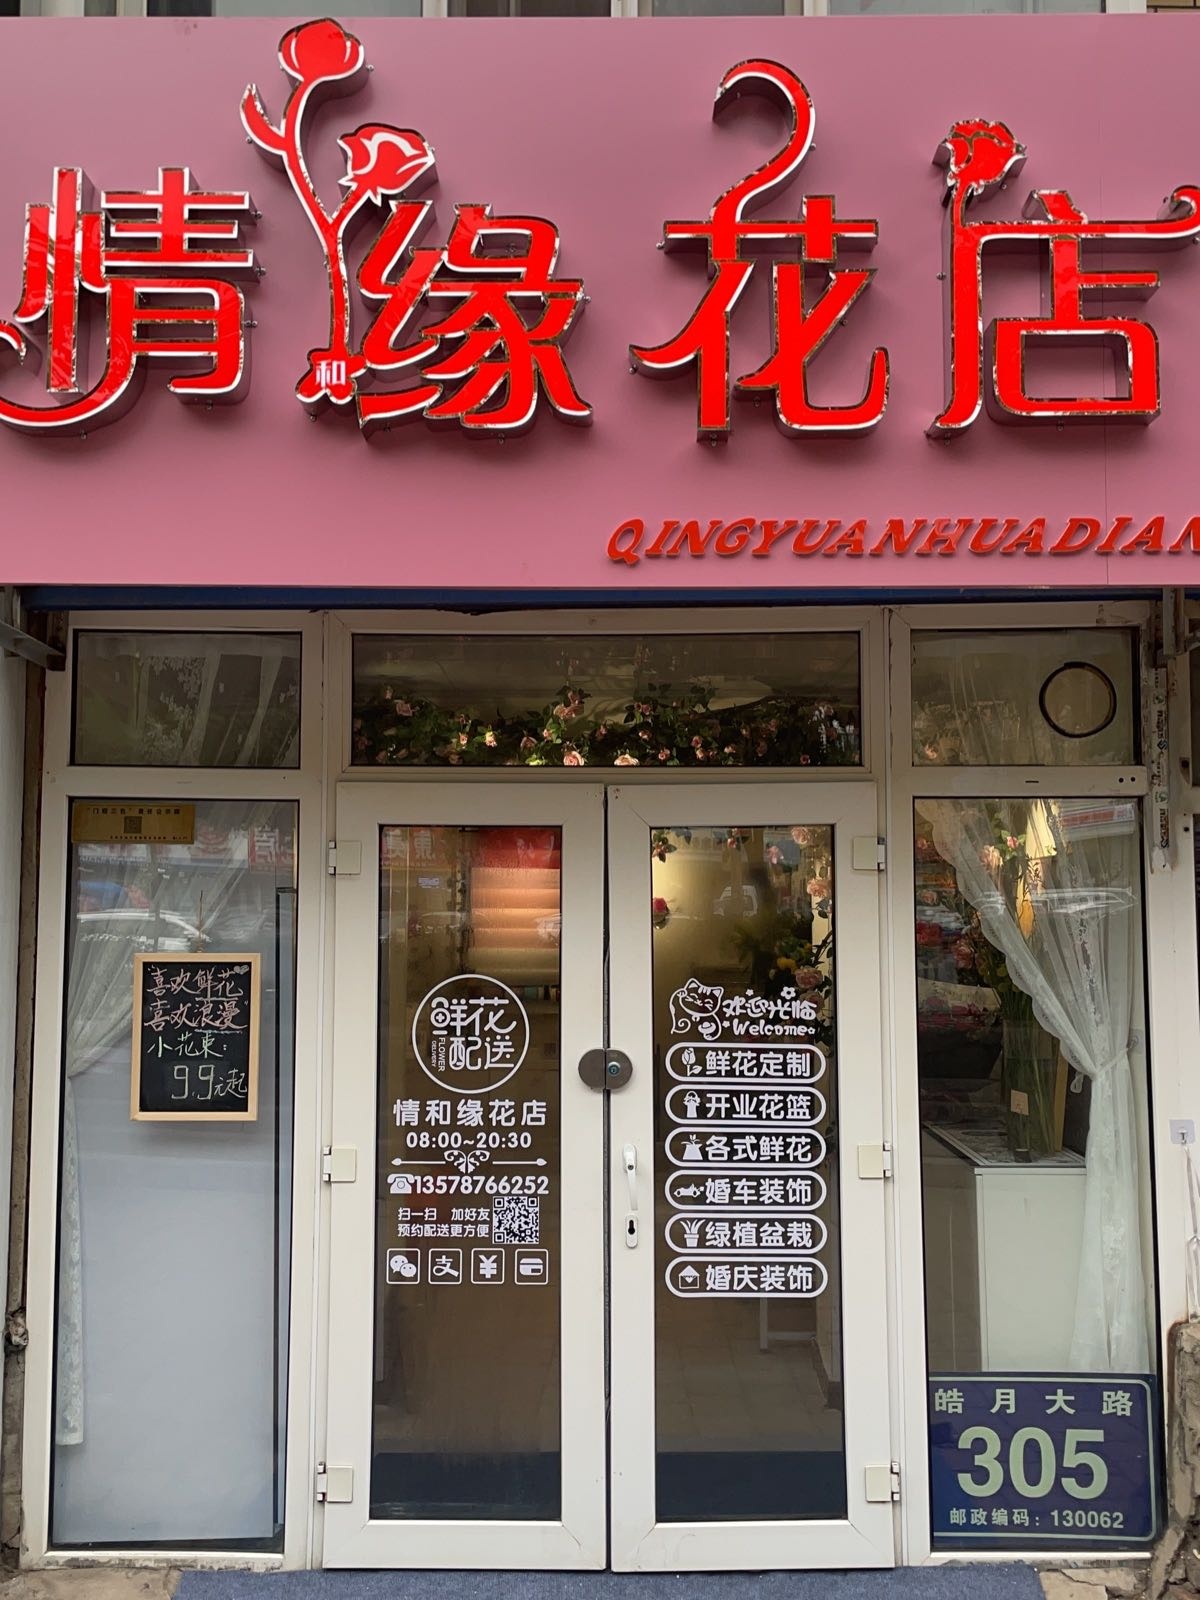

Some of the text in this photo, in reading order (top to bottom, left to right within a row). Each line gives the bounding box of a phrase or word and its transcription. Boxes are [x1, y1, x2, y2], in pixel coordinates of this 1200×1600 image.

[722, 995, 818, 1020] 欢迎光临
[732, 1018, 808, 1036] Welcome
[438, 1037, 446, 1072] FLOWER
[705, 1050, 811, 1077] 鲜花定制
[393, 1099, 547, 1127] 情和缘花店
[705, 1093, 812, 1120] 开业花篮
[406, 1132, 532, 1149] 08:00~20:30
[705, 1135, 812, 1162] 各式鲜花
[414, 1175, 549, 1194] 13578766252
[705, 1178, 812, 1205] 婚车装饰
[398, 1207, 490, 1221] 扫一扫 加好友
[398, 1223, 489, 1238] 预约配送更方便
[705, 1221, 813, 1248] 绿植盆栽
[705, 1264, 814, 1291] 婚庆装饰
[934, 1388, 1133, 1416] 皓月大路
[957, 1426, 1109, 1500] 305
